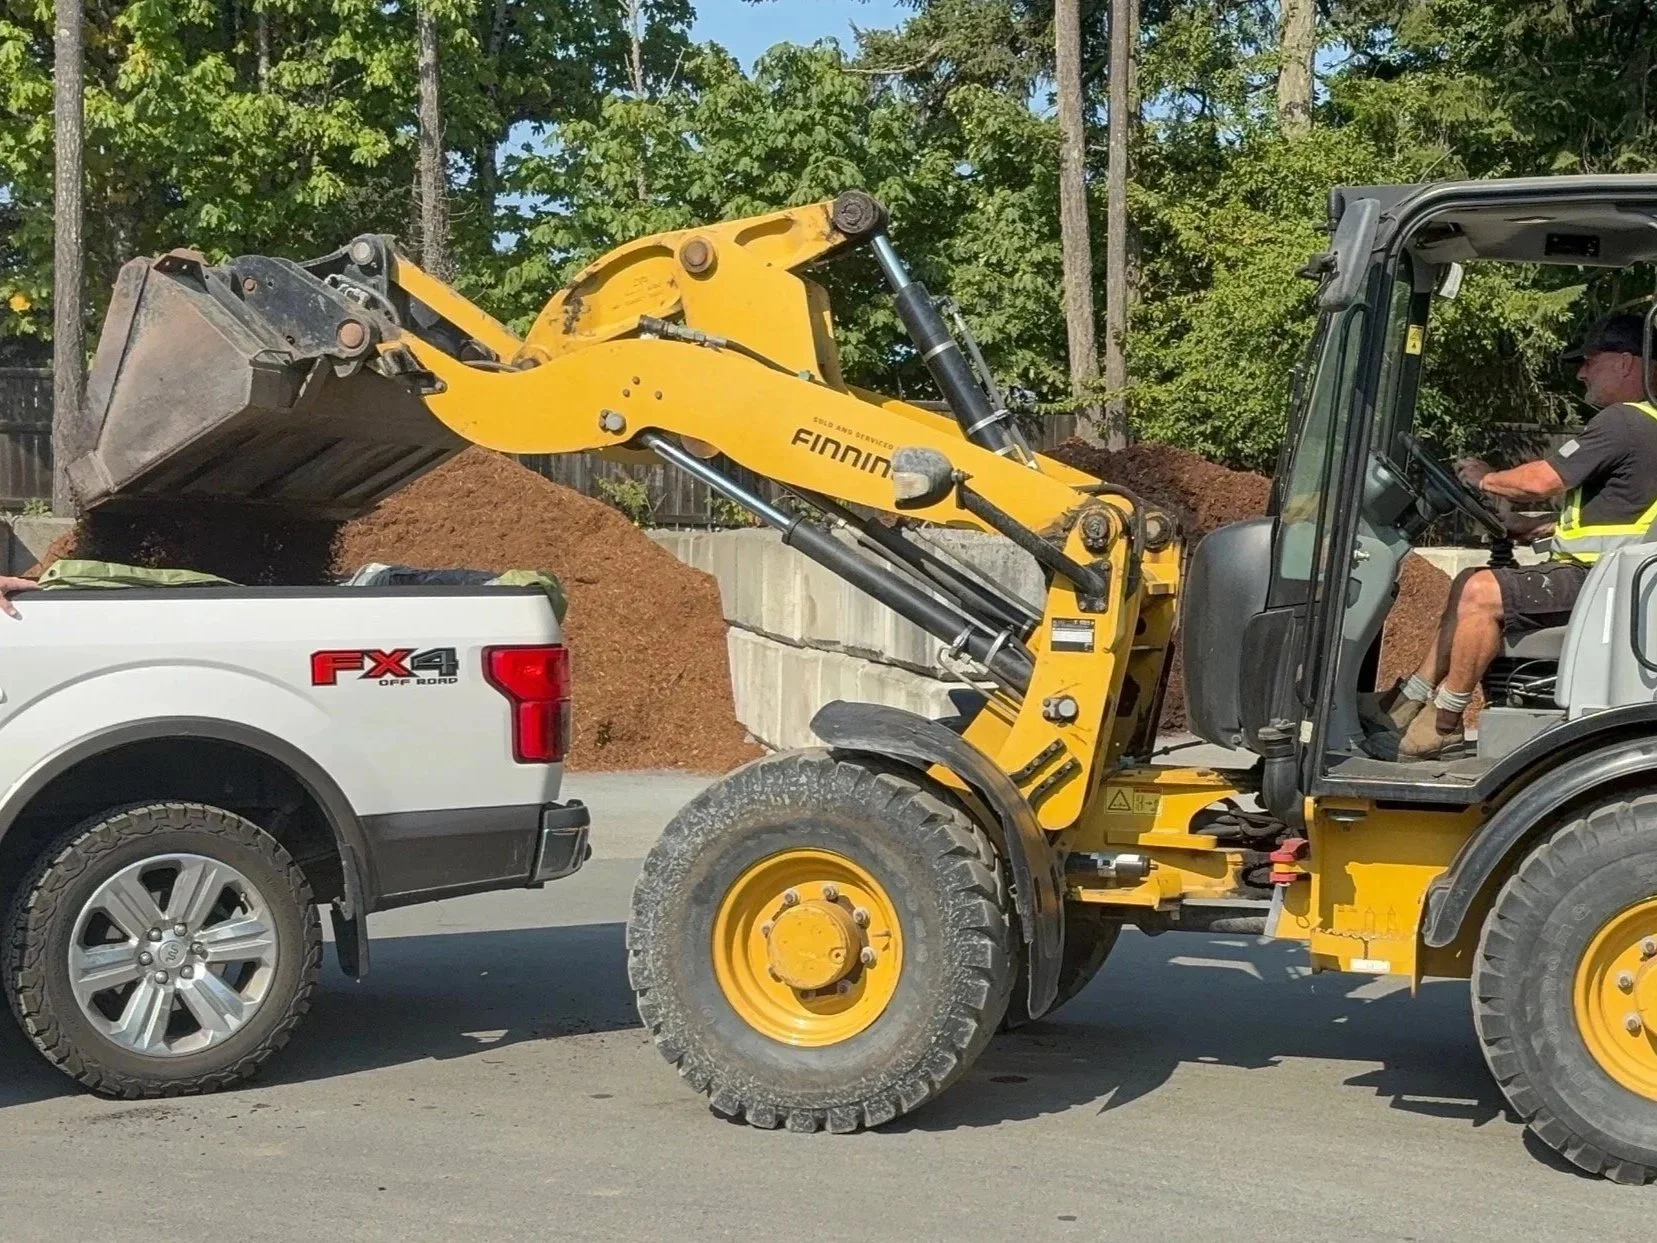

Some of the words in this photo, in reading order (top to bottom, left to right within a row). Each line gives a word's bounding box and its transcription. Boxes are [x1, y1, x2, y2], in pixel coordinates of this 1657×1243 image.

[812, 416, 834, 429] SOLD
[835, 425, 853, 436] AND
[855, 431, 894, 450] SERVICED
[791, 427, 894, 481] FINNIN
[309, 647, 459, 687] FX4
[378, 678, 411, 687] OFF
[416, 677, 458, 685] ROAD
